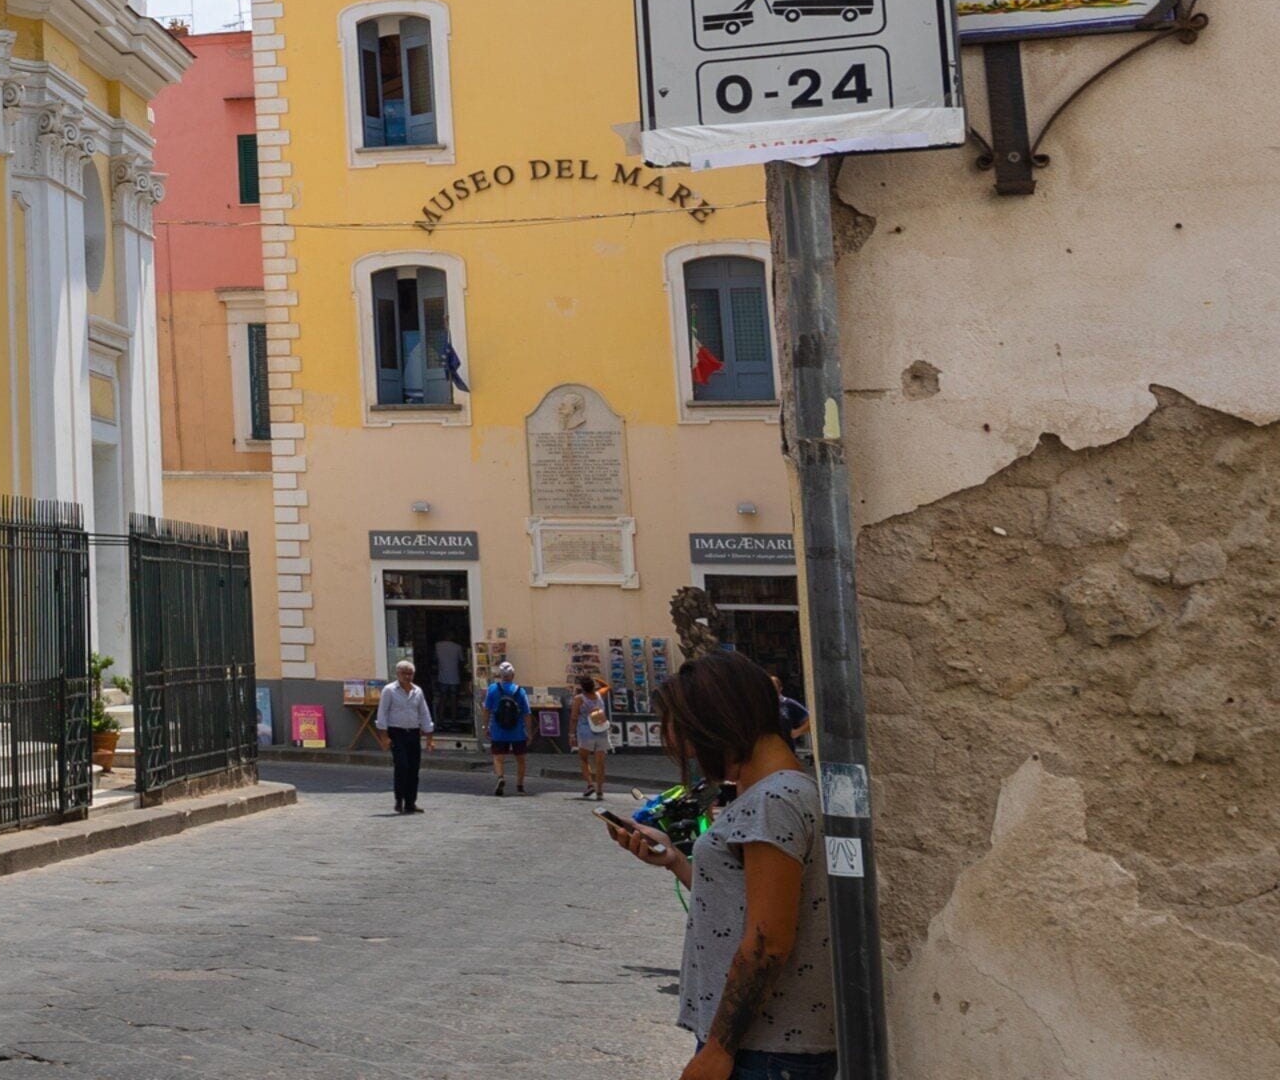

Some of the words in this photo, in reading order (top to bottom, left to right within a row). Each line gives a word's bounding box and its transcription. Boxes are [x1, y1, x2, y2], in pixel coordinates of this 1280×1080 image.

[413, 165, 515, 236] MUSEO
[529, 159, 599, 181] DEL
[612, 162, 716, 225] MARE
[373, 534, 473, 546] IMAGÆNARIA
[695, 537, 795, 550] IMAGÆNARI
